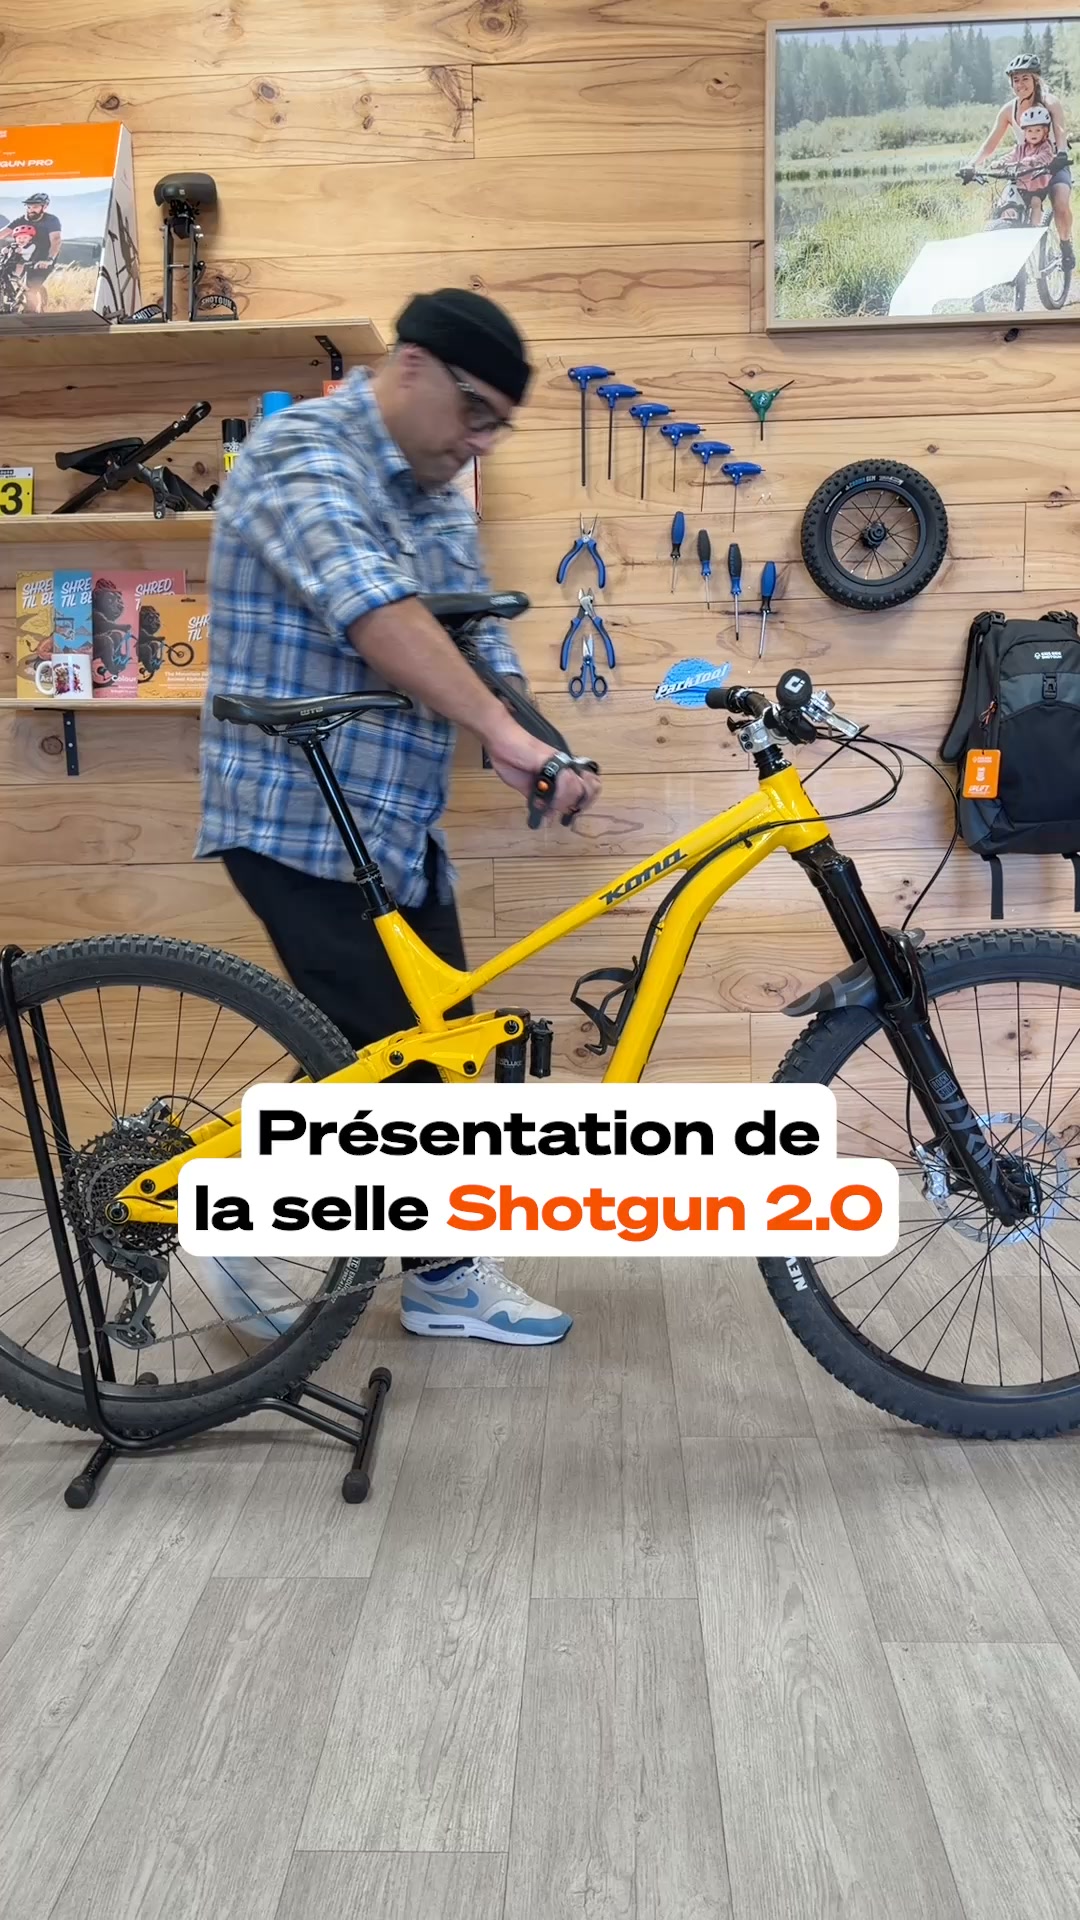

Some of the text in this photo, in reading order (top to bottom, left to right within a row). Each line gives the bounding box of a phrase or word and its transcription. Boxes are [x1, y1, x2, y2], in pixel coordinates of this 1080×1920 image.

[28, 159, 54, 167] PRO
[0, 482, 23, 515] 3
[22, 578, 54, 596] SHRE
[61, 577, 92, 595] SHRE
[134, 578, 172, 597] SHRED
[22, 591, 54, 609] TIL BE
[61, 591, 92, 608] TIL BE
[187, 628, 203, 642] TIL
